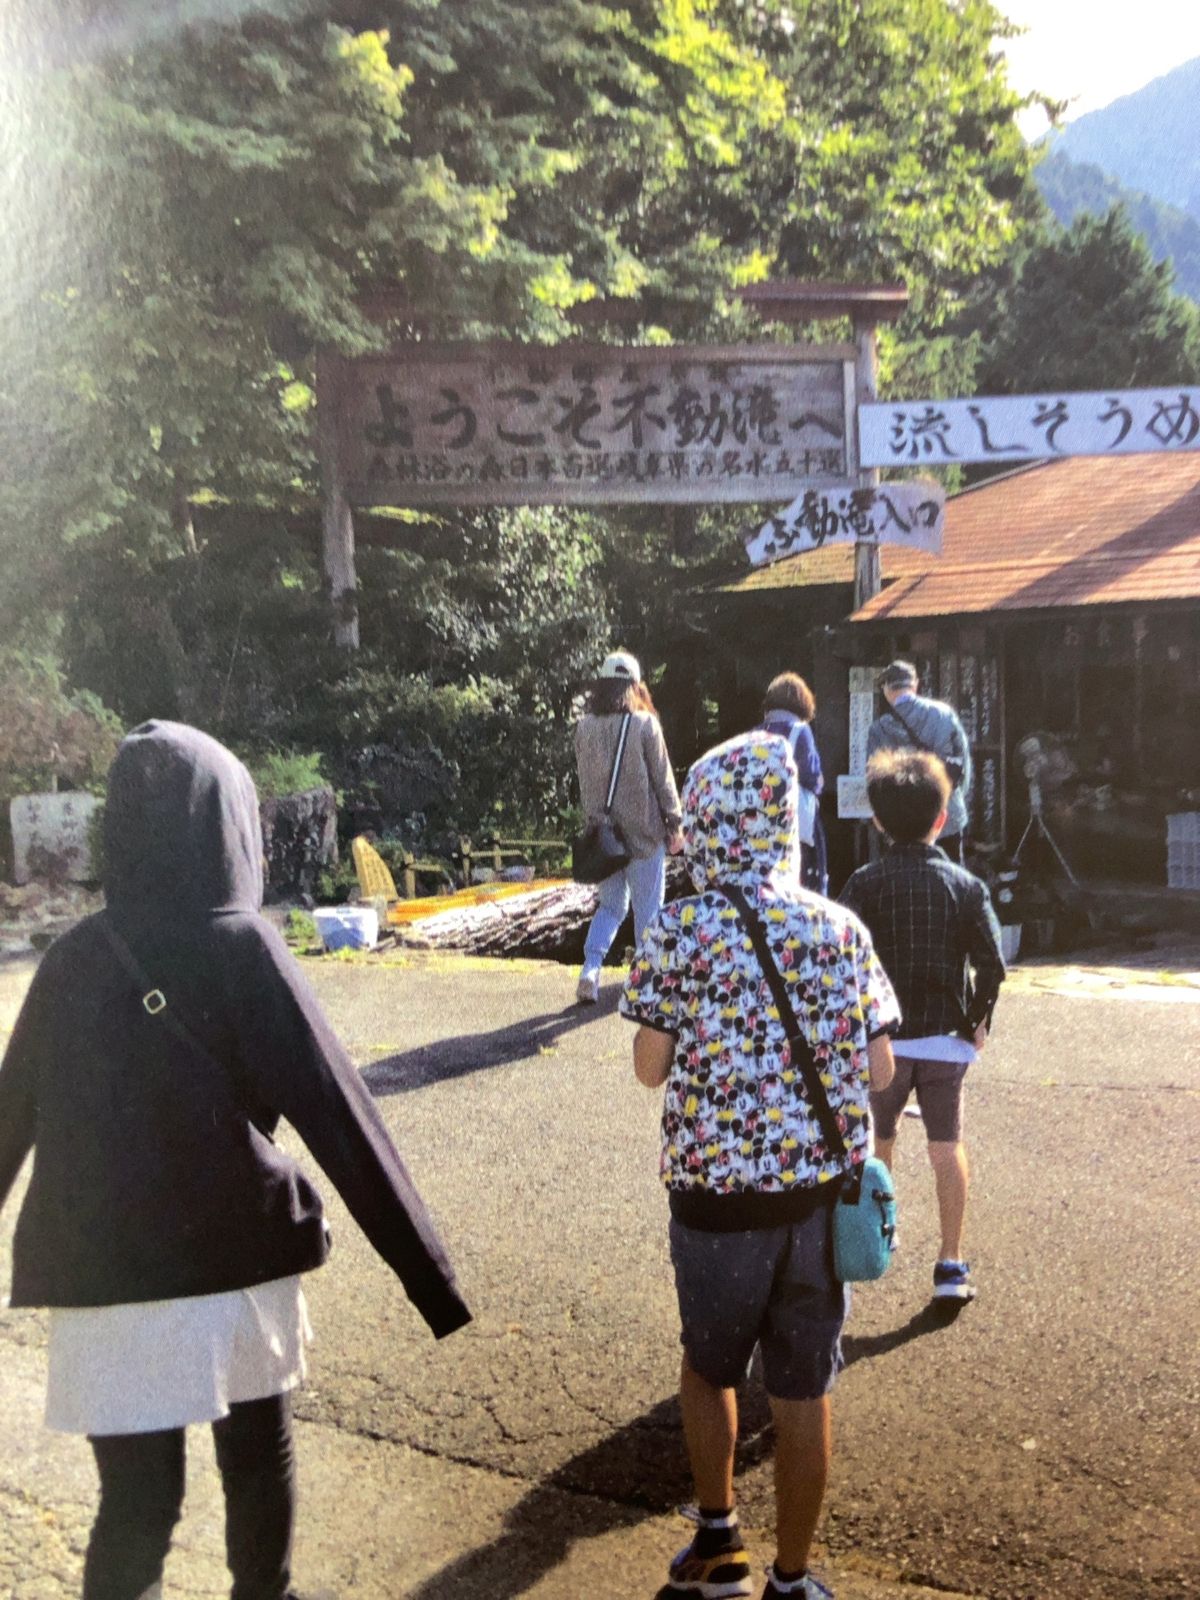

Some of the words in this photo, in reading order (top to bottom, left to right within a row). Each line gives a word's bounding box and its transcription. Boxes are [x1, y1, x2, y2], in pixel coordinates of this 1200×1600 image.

[364, 384, 842, 450] ようこそ不動滝へ
[889, 394, 1199, 458] 流しそうめ
